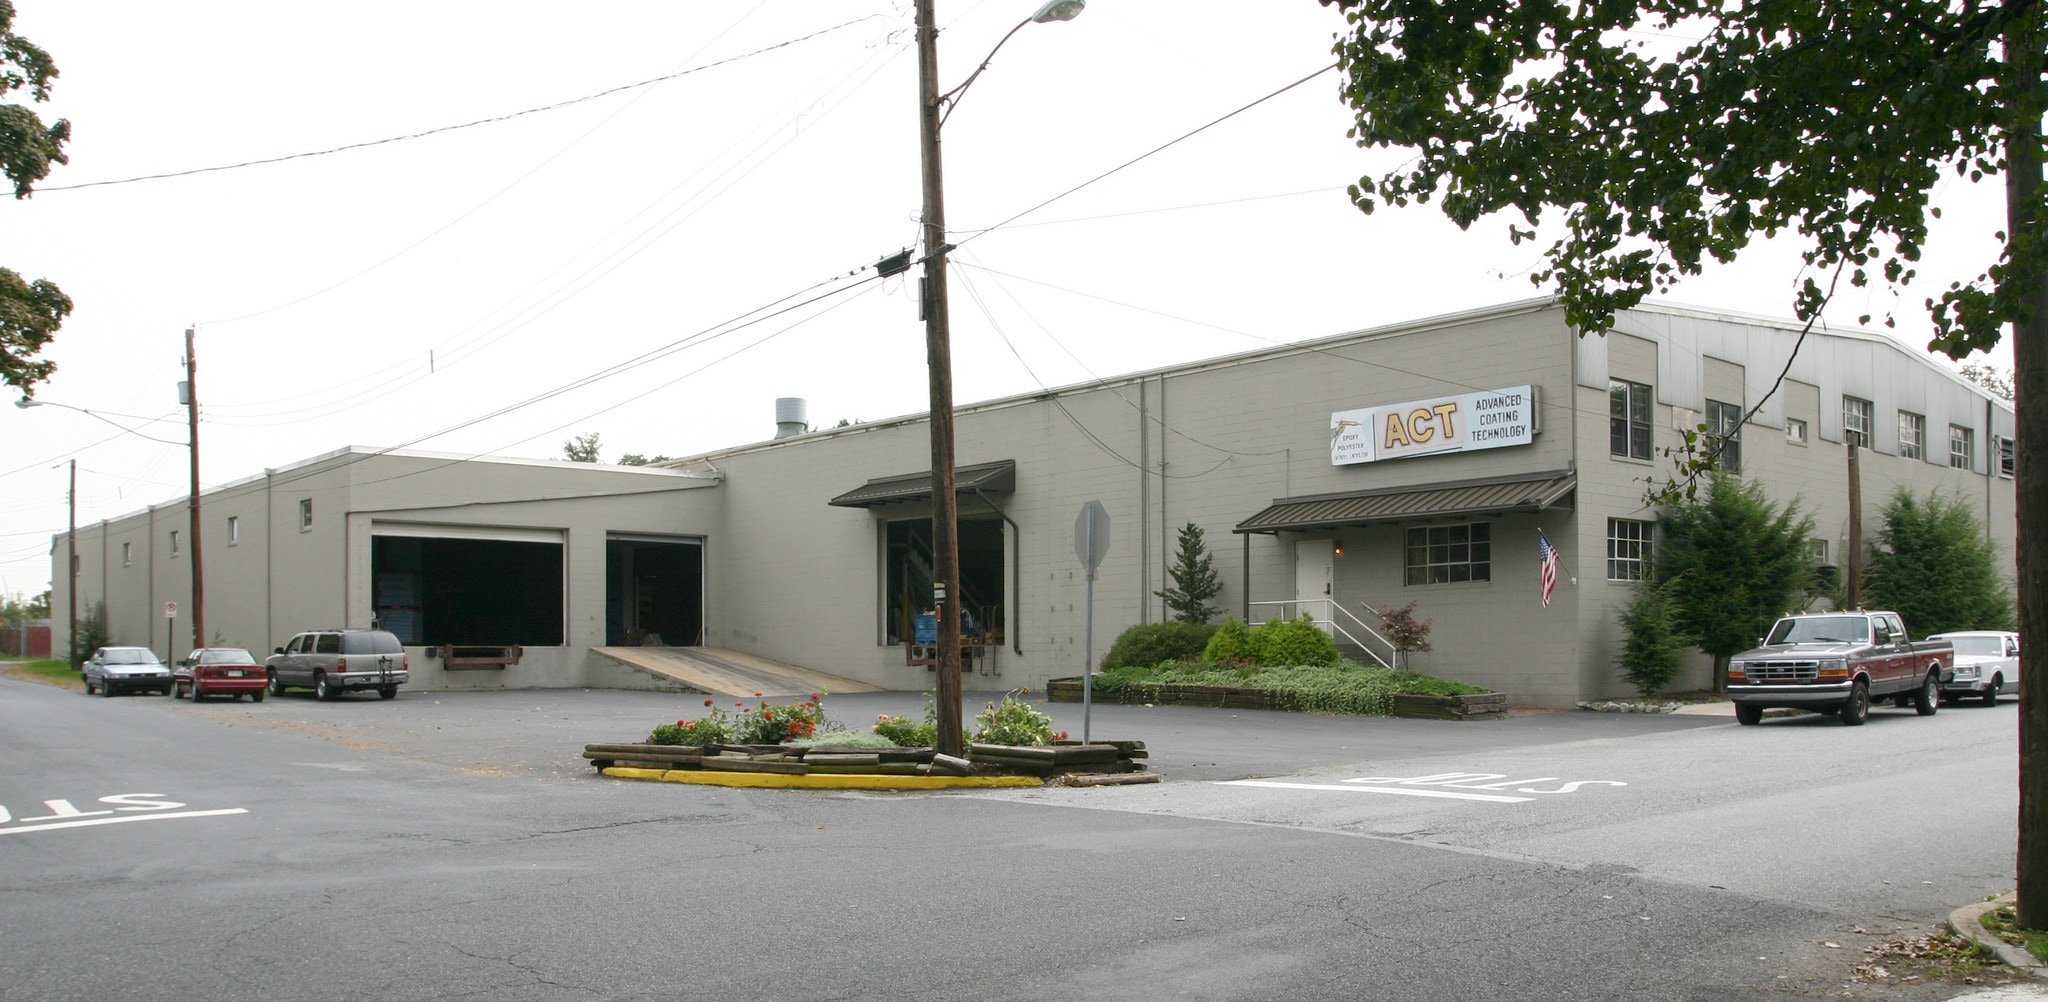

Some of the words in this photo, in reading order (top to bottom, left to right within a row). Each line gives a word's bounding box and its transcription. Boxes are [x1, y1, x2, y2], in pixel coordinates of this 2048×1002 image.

[1475, 394, 1522, 411] ADVANCED
[1384, 402, 1457, 449] ACT
[1479, 410, 1519, 426] COATING
[1471, 424, 1527, 442] TECHNOLOGY
[0, 793, 187, 824] ST
